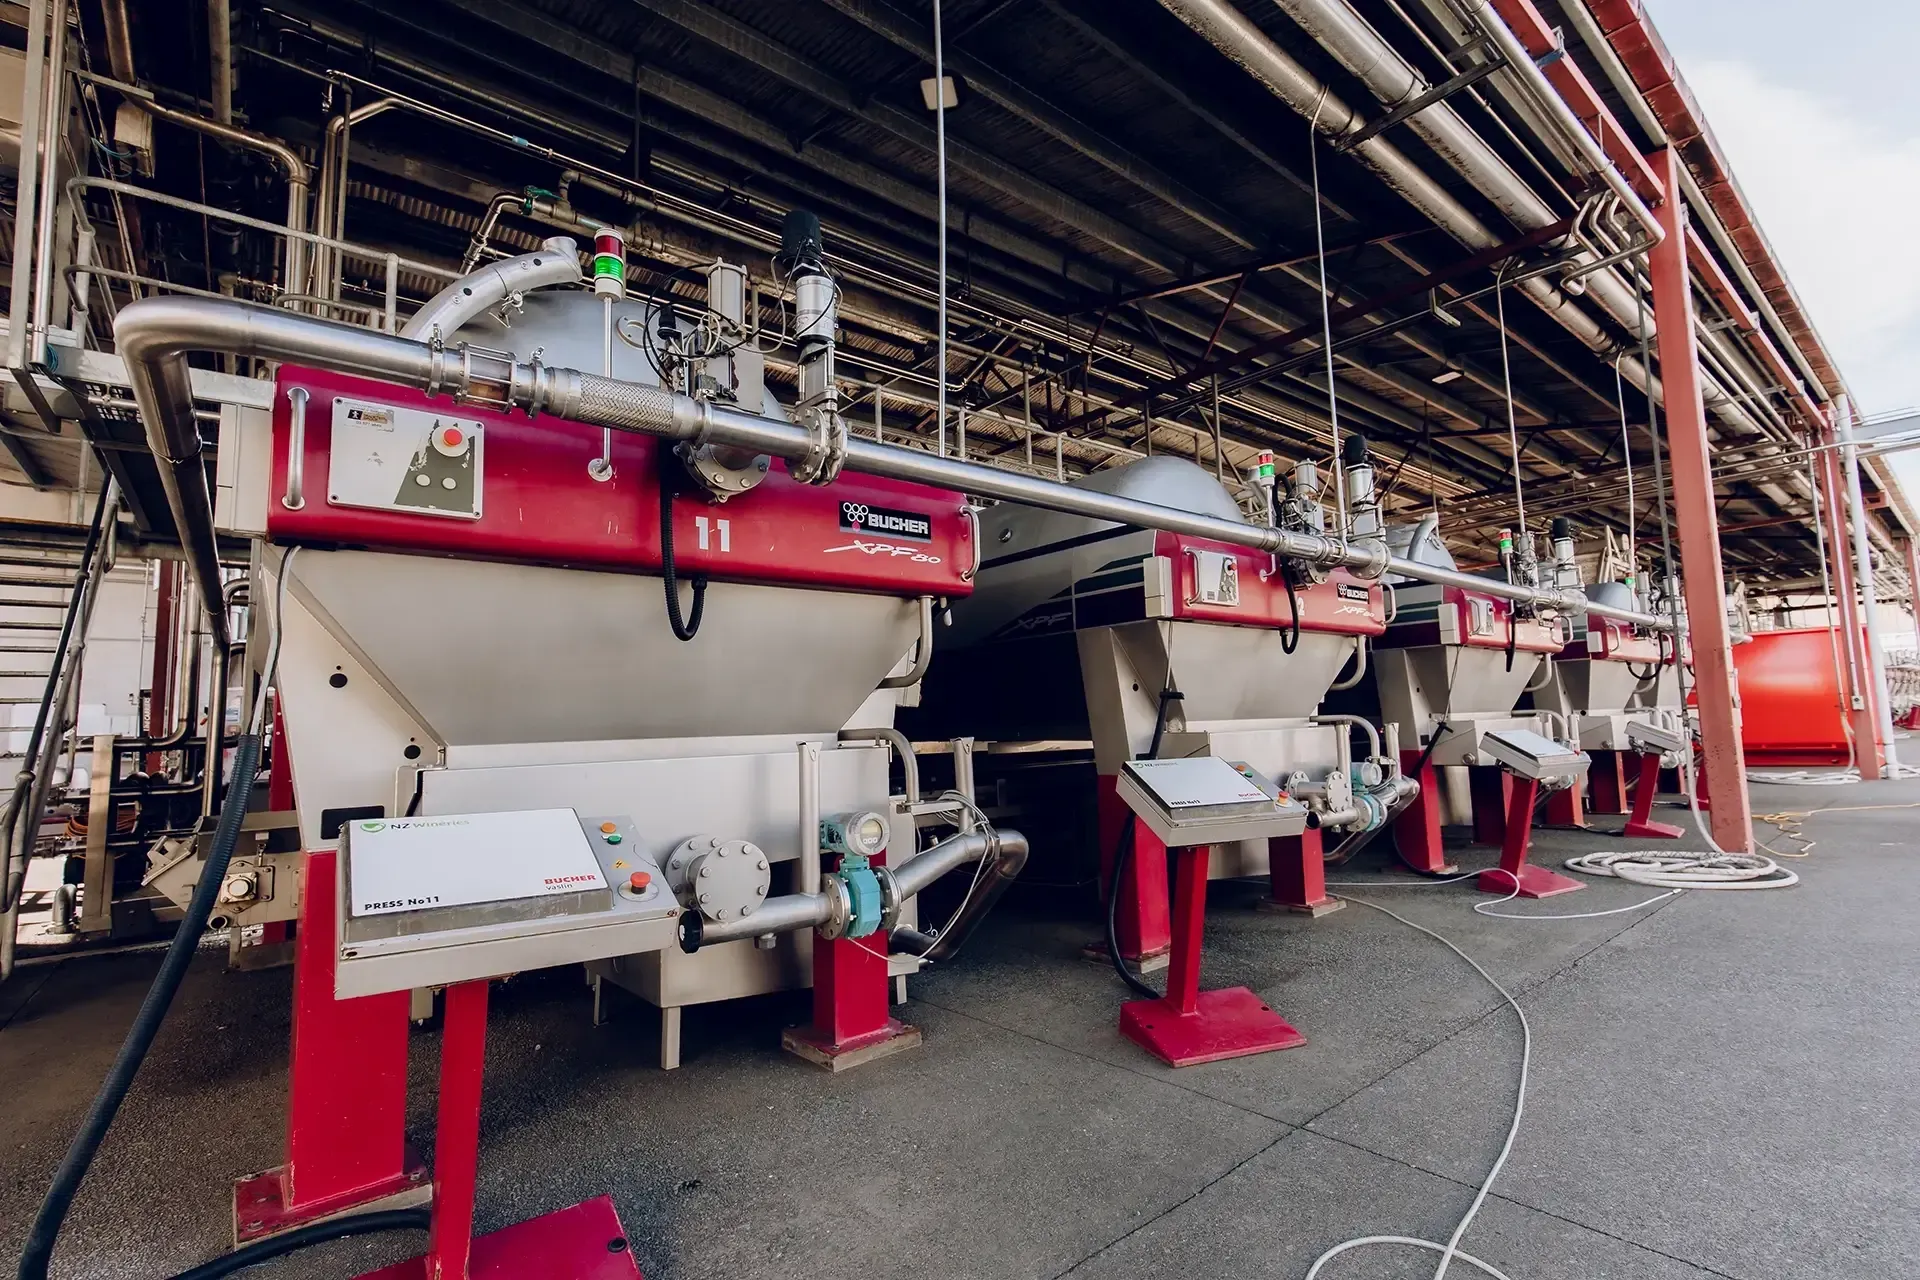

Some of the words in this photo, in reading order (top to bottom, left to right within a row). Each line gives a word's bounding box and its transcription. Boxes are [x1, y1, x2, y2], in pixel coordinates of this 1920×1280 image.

[868, 513, 928, 535] BUCHER
[695, 515, 730, 553] 11
[1346, 588, 1369, 600] BUCHER
[412, 819, 470, 829] Wineries
[544, 874, 597, 885] BUCHER
[364, 899, 404, 911] PRESS
